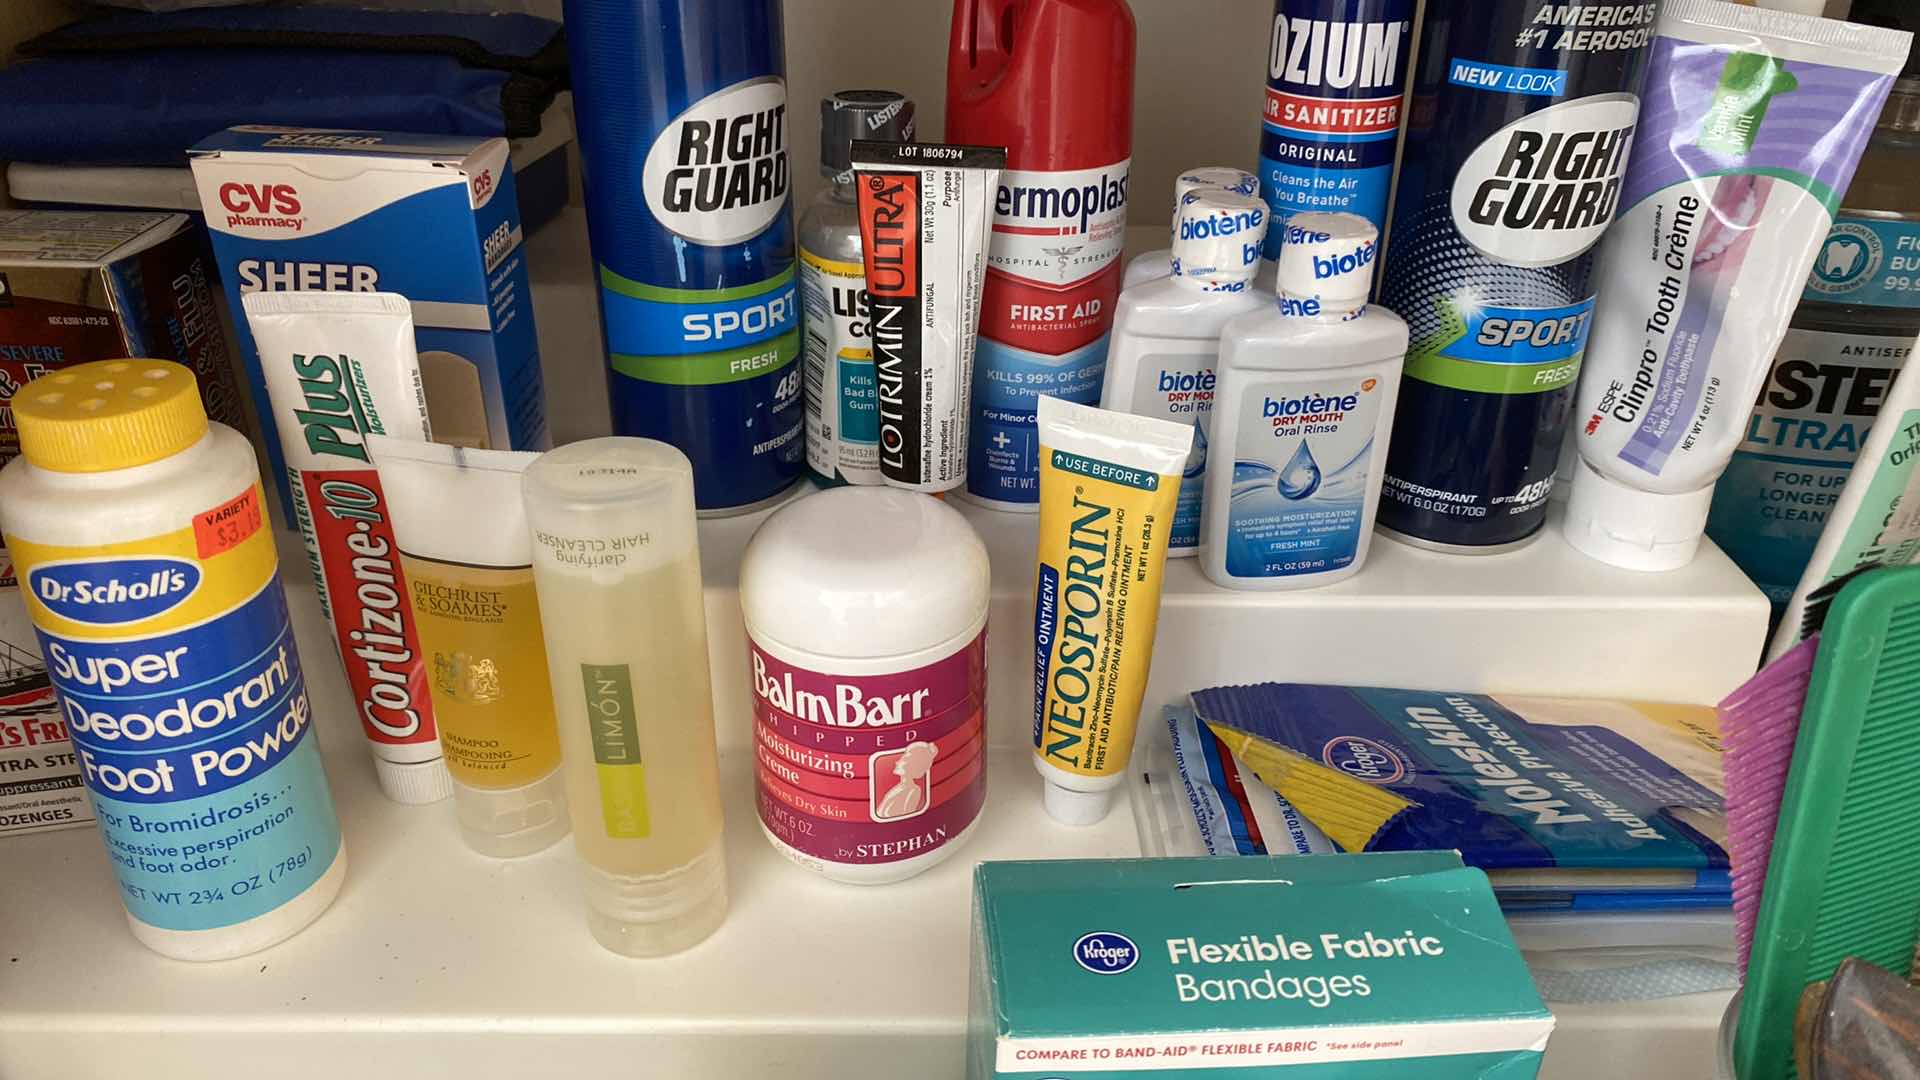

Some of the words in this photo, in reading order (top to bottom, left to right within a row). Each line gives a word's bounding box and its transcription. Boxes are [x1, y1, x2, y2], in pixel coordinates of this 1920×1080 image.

[1532, 3, 1657, 27] AMERICA'S
[1515, 28, 1550, 49] #1
[1552, 28, 1649, 51] AEROSOL
[1452, 64, 1502, 87] NEW
[1504, 72, 1561, 96] LOOK
[1284, 103, 1398, 128] SANITIZER
[1727, 113, 1754, 146] Mint
[677, 104, 786, 167] RIGHT
[898, 146, 918, 158] LOT
[922, 147, 964, 161] 1806794
[1279, 143, 1358, 163] ORIGINAL
[1499, 127, 1634, 180] RIGHT
[474, 168, 493, 196] CVS
[662, 157, 788, 213] GUARD
[942, 170, 952, 208] Purpose
[1272, 169, 1311, 189] Cleans
[1313, 176, 1335, 190] the
[1338, 177, 1359, 190] Air
[219, 182, 302, 217] CVS
[1275, 187, 1294, 202] You
[1296, 191, 1349, 207] Breathe
[1466, 177, 1616, 231] GUARD
[226, 213, 304, 232] pharmacy
[1180, 207, 1263, 241] biotène
[988, 255, 1049, 267] HOSPITAL
[1646, 277, 1681, 335] Tooth
[1664, 195, 1700, 271] Crème
[238, 260, 379, 292] SHEER
[681, 286, 799, 343] SPORT
[925, 282, 935, 329] ANTIFUNGAL
[1009, 304, 1069, 322] FIRST
[1071, 299, 1102, 319] AID
[1009, 322, 1077, 332] ANTIBACTERIAL
[1477, 308, 1593, 348] SPORT
[729, 352, 779, 375] FRESH
[1675, 332, 1700, 388] Toothpaste
[849, 375, 873, 386] Kills
[879, 304, 906, 471] LOTRIMIN
[987, 368, 1024, 384] KILLS
[1026, 373, 1055, 385] 99%
[1057, 371, 1076, 383] OF
[1005, 386, 1017, 396] To
[350, 360, 387, 436] Moisturizers
[844, 387, 865, 398] Bad
[849, 401, 875, 411] Gum
[1168, 391, 1192, 403] DRY
[1263, 391, 1358, 418] biotène
[1599, 379, 1624, 414] ESPE
[292, 353, 373, 465] Plus
[983, 409, 998, 419] For
[999, 412, 1026, 423] Minor
[1169, 402, 1194, 413] Oral
[1273, 416, 1298, 427] DRY
[1299, 412, 1344, 425] MOUTH
[939, 419, 949, 457] Ingredient
[1274, 425, 1301, 438] Oral
[1304, 424, 1338, 437] Rinse
[1681, 433, 1697, 452] NET
[938, 457, 948, 482] Active
[1000, 476, 1018, 488] NET
[1020, 478, 1037, 490] WT.
[1065, 457, 1090, 473] USE
[1091, 463, 1142, 486] BEFORE
[1772, 470, 1812, 488] FOR
[1818, 475, 1846, 488] UP
[1382, 473, 1479, 504] ANTIPERSPIRANT
[204, 495, 250, 528] VARIETY
[287, 466, 317, 546] STRENGTH
[1234, 516, 1281, 528] SOOTHING
[1282, 509, 1358, 521] MOISTURIZATION
[1396, 491, 1412, 505] WT
[1413, 497, 1433, 510] 6.0
[1432, 500, 1450, 514] OZ
[1449, 504, 1487, 518] (170G)
[1760, 505, 1826, 524] CLEAN
[535, 529, 607, 552] CLEANSER
[611, 531, 650, 551] HAIR
[1270, 542, 1299, 551] FRESH
[1299, 538, 1321, 548] MINT
[555, 549, 627, 569] clarifying
[1119, 544, 1134, 600] OINTMENT
[1271, 564, 1283, 572] FL
[1283, 562, 1297, 570] OZ
[306, 549, 332, 620] MAXIMUM
[1136, 569, 1147, 582] NET
[413, 580, 502, 605] GILCHRIST
[429, 596, 503, 618] SOAMES
[1037, 573, 1055, 646] OINTMENT
[1114, 600, 1128, 648] RELIEVING
[49, 642, 188, 693] Super
[1035, 647, 1048, 697] RELIEF
[63, 645, 290, 743] Deodorant
[752, 649, 930, 728] BalmBarr
[1103, 647, 1122, 727] ANTIBIOTIC/PAIN
[589, 679, 628, 760] LIMÓN
[1444, 696, 1554, 769] Protection
[757, 722, 855, 779] Moisturizing
[1102, 728, 1110, 744] AID
[758, 744, 801, 785] Creme
[1083, 732, 1097, 770] Bacitracin
[1095, 744, 1107, 771] FIRST
[1341, 741, 1388, 777] Kroger
[1405, 705, 1593, 826] Moleskin
[79, 748, 175, 795] Foot
[97, 803, 123, 829] For
[794, 796, 817, 814] Dry
[820, 802, 849, 819] Skin
[1545, 771, 1667, 841] Adhesive
[104, 829, 179, 858] Excessive
[182, 805, 294, 860] perspiration
[837, 847, 853, 858] by
[856, 823, 947, 858] STEPHAN
[119, 879, 147, 901] NET
[151, 891, 183, 905] WT
[231, 874, 264, 897] OZ
[268, 845, 313, 885] (78g)
[140, 855, 176, 875] foot
[180, 854, 237, 874] odor.
[1083, 938, 1131, 967] Kroger
[1166, 933, 1313, 965] Flexible
[1319, 929, 1445, 960] Fabric
[1175, 968, 1372, 1008] Bandages
[1015, 1048, 1088, 1061] COMPARE
[1093, 1047, 1111, 1060] TO
[1201, 1042, 1263, 1056] FLEXIBLE
[1266, 1040, 1319, 1055] FABRIC
[1350, 1040, 1373, 1051] side
[1373, 1039, 1404, 1051] panel
